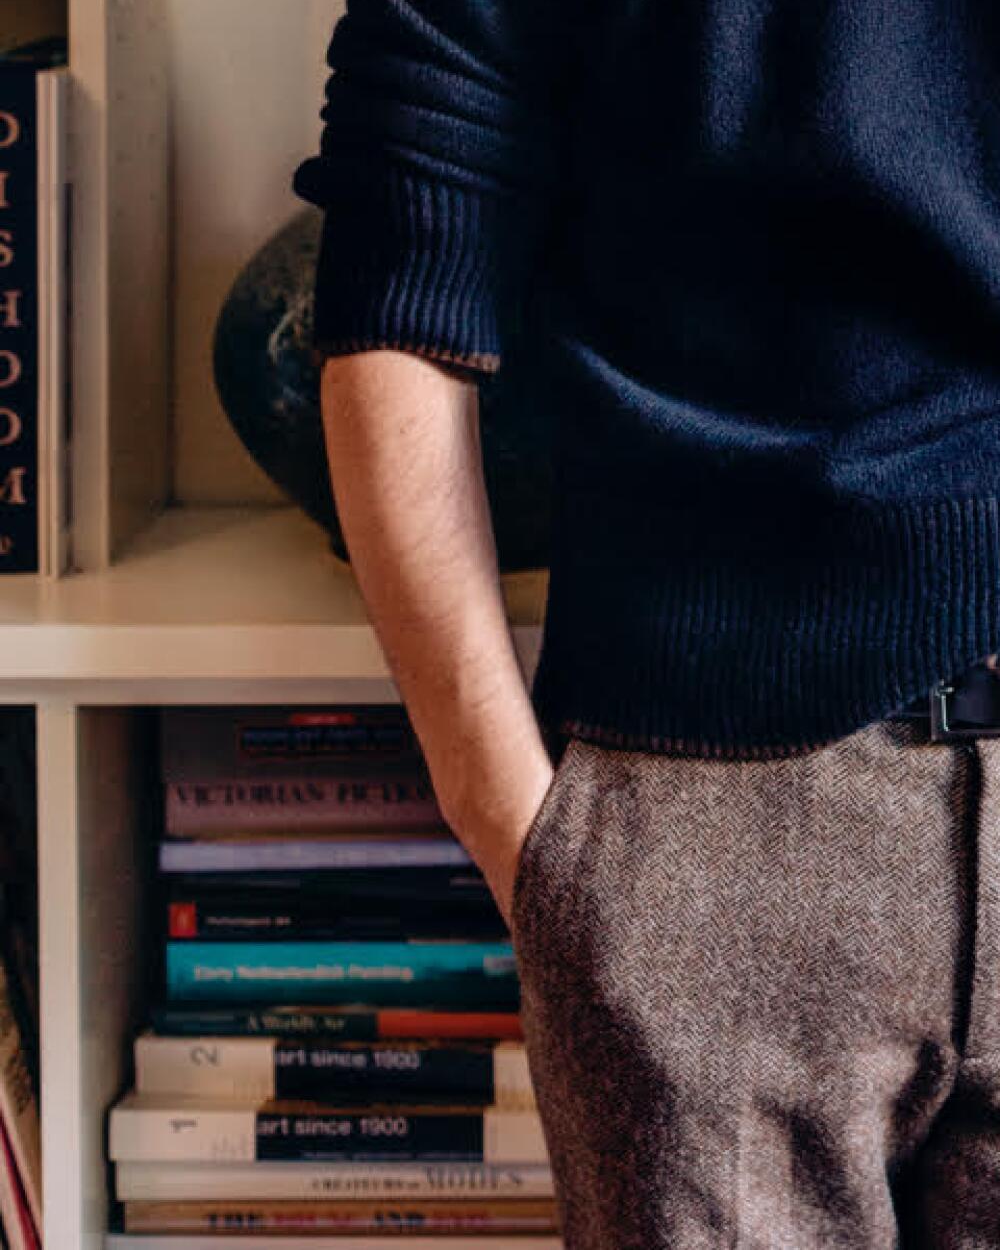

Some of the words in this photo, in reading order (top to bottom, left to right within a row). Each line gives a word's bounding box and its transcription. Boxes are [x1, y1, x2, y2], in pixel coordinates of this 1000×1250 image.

[175, 782, 324, 807] VICTORIAN
[274, 1050, 307, 1067] art
[309, 1050, 367, 1069] since
[372, 1051, 421, 1069] 1900
[257, 1117, 289, 1135] art
[293, 1116, 351, 1135] since
[358, 1117, 409, 1136] 1900
